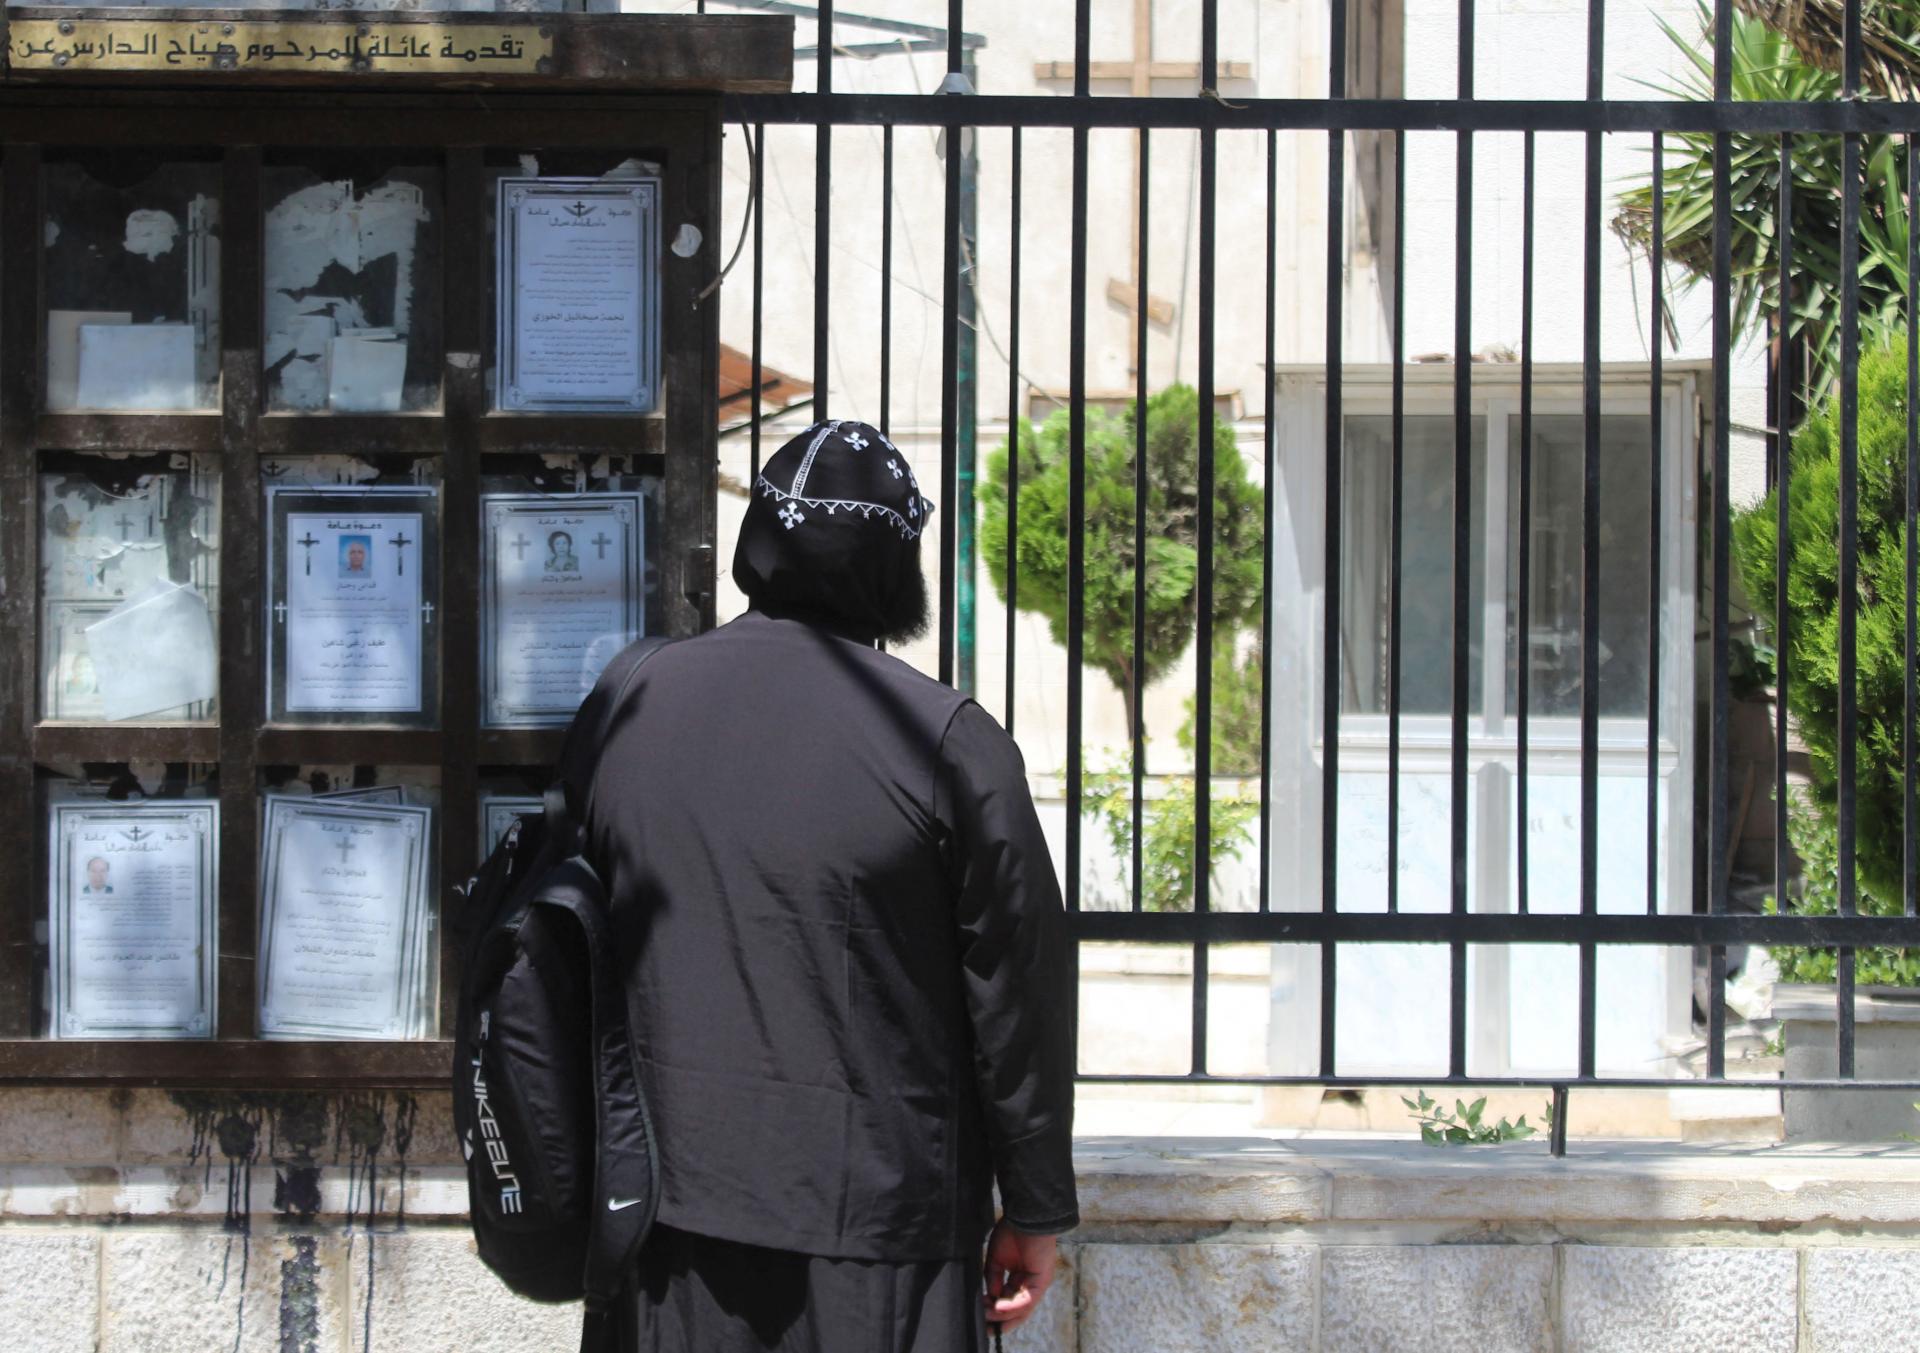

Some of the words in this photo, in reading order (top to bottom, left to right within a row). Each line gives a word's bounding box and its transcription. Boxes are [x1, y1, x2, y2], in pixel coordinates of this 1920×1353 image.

[17, 38, 55, 58] عن
[66, 33, 157, 60] الدارس
[368, 34, 431, 58] عائلة
[440, 34, 524, 62] تقدمة
